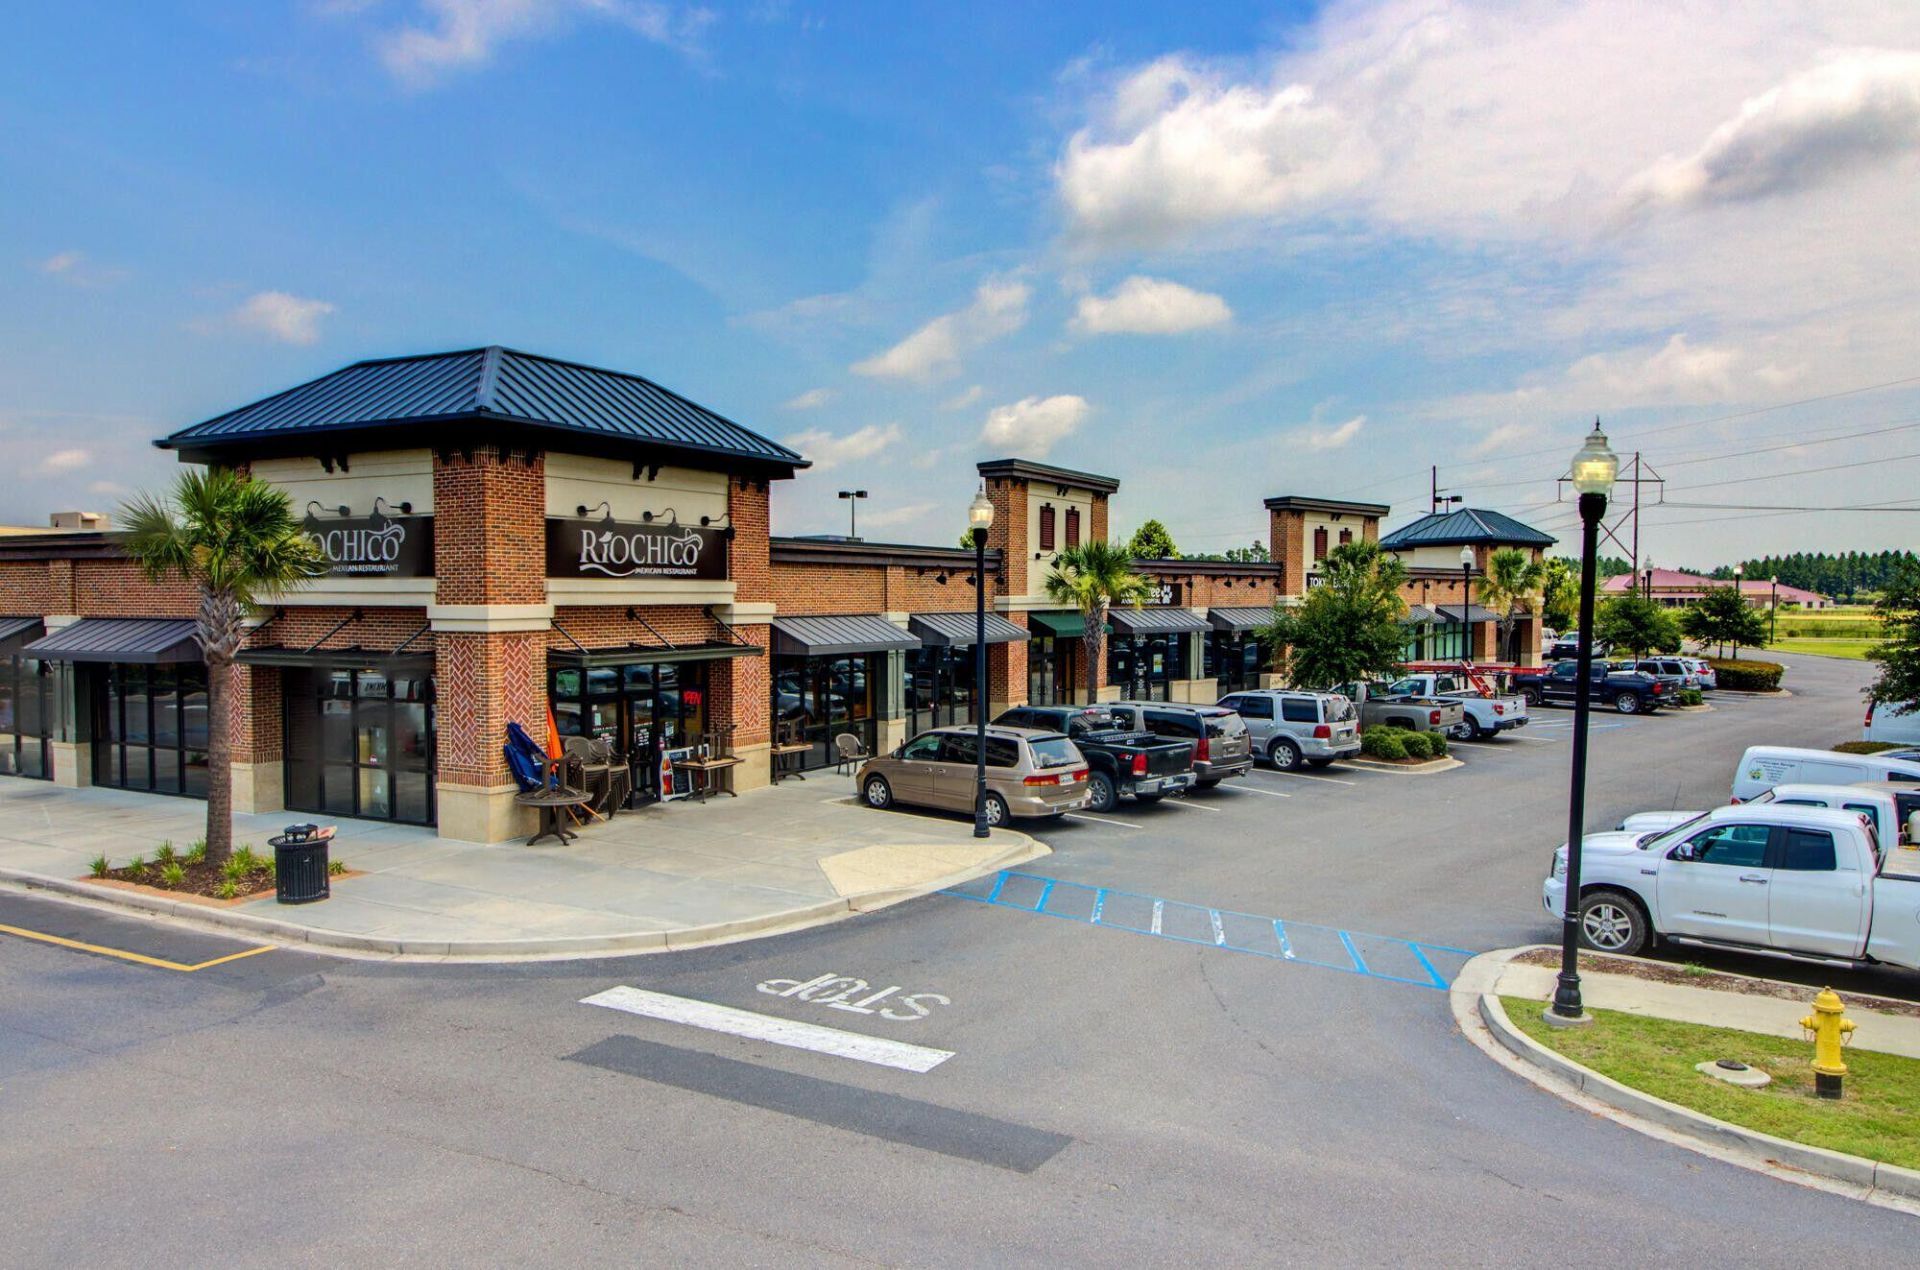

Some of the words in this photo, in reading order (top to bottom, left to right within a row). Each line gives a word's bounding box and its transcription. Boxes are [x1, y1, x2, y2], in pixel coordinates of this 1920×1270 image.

[634, 567, 662, 575] MEXICAN
[663, 567, 698, 575] RESTAURANT
[756, 972, 951, 1021] STOP
